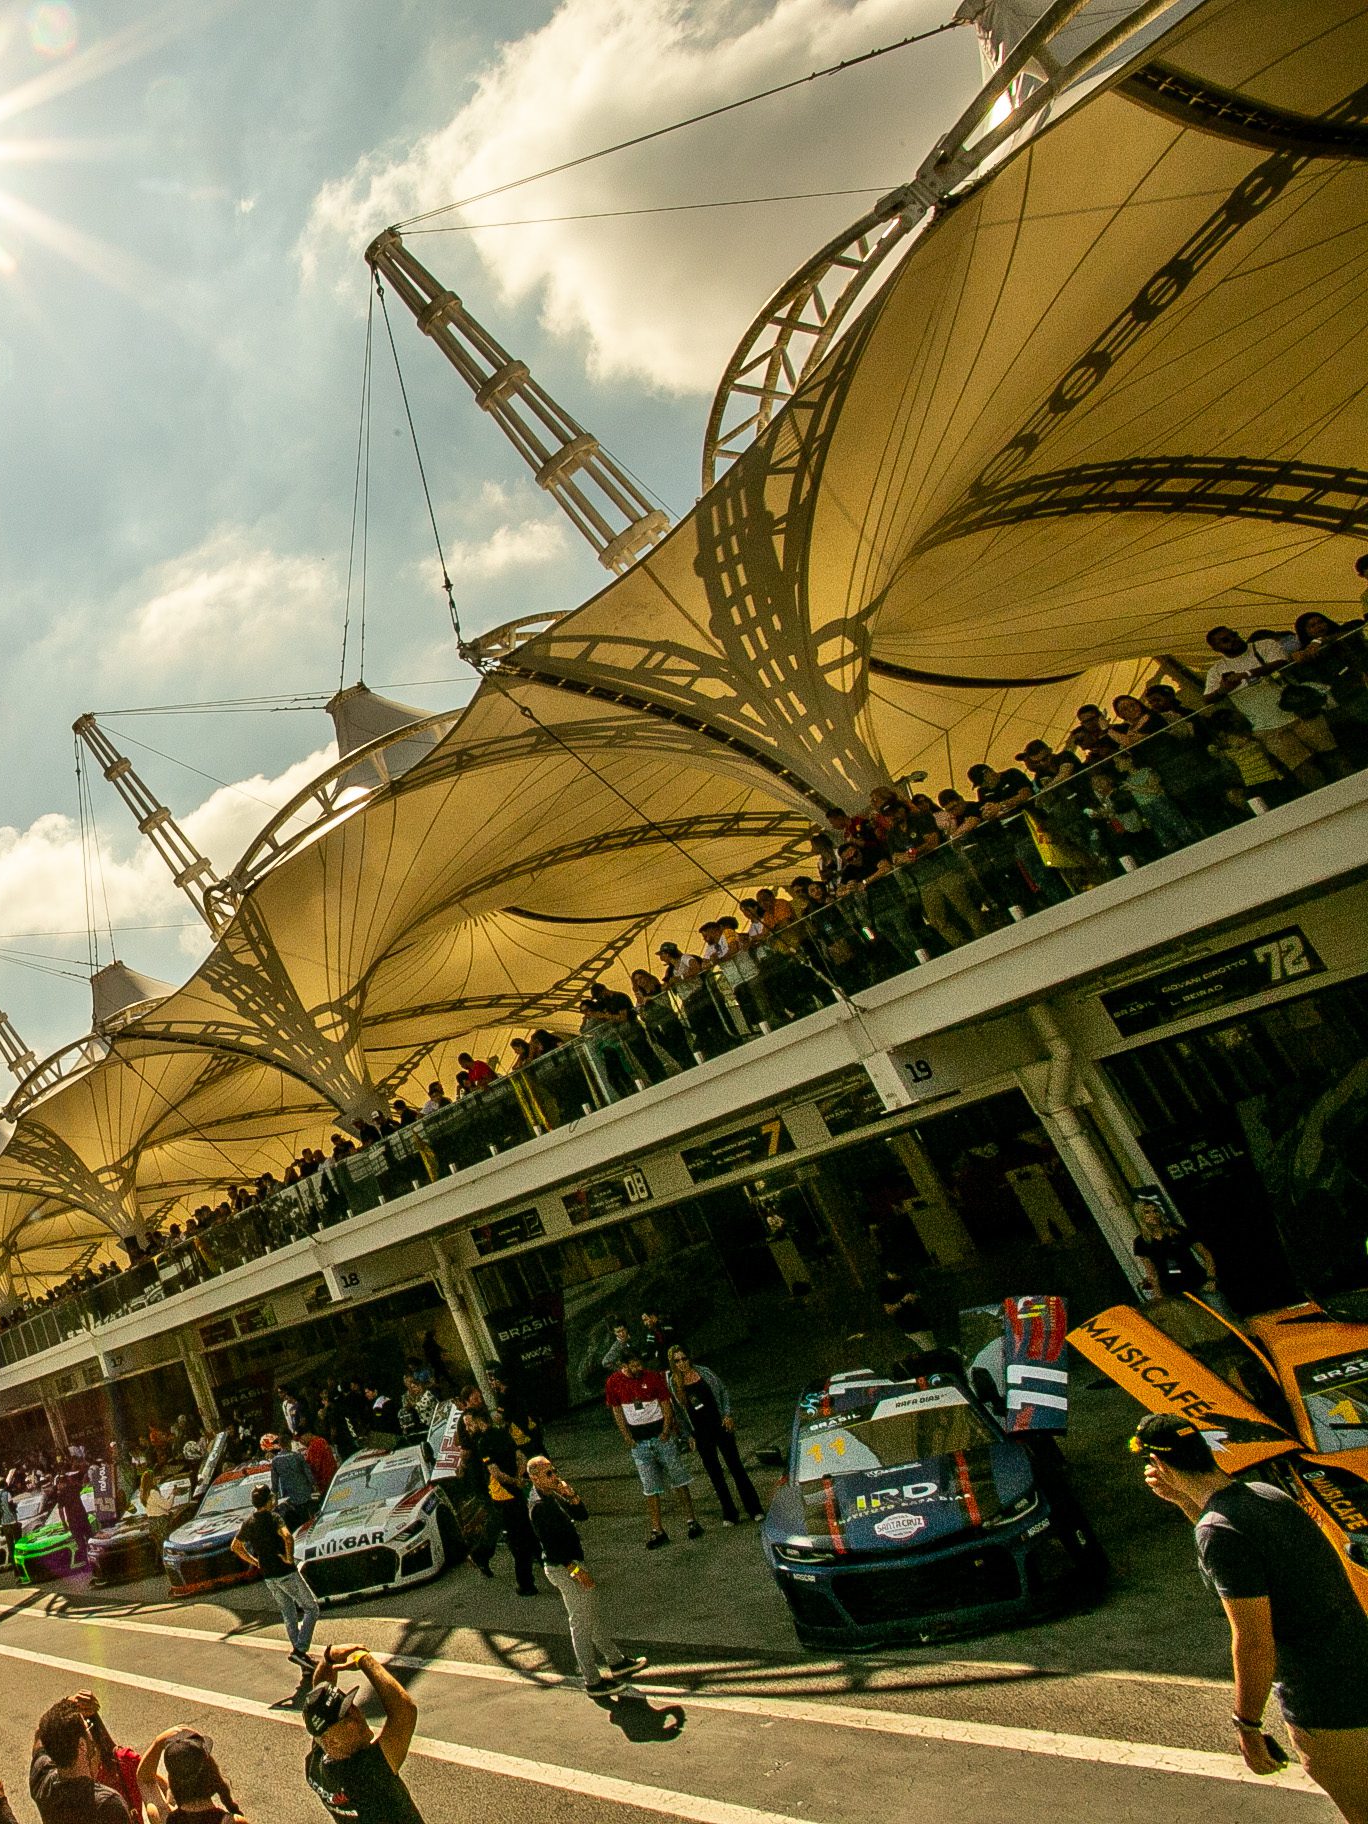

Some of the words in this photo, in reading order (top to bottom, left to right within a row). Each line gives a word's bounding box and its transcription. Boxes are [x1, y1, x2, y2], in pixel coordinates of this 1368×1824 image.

[1254, 935, 1311, 981] 72
[905, 1060, 933, 1083] 19
[761, 1120, 781, 1156] 7
[1167, 1144, 1244, 1180] BRASIL
[340, 1273, 360, 1288] 18
[498, 1316, 558, 1342] BRASIL
[110, 1356, 123, 1368] 17
[1079, 1318, 1217, 1418] MAIS1.CAFÉ
[221, 1388, 269, 1408] BRASIL
[1007, 1365, 1068, 1411] 11
[895, 1398, 919, 1408] RAFA
[919, 1394, 940, 1404] DIAS
[809, 1413, 862, 1431] BRASIL
[807, 1436, 846, 1464] 11
[856, 1482, 938, 1510] IRD
[900, 1496, 934, 1508] RAFA
[938, 1493, 971, 1502] DIAS
[902, 1518, 922, 1527] CRUZ
